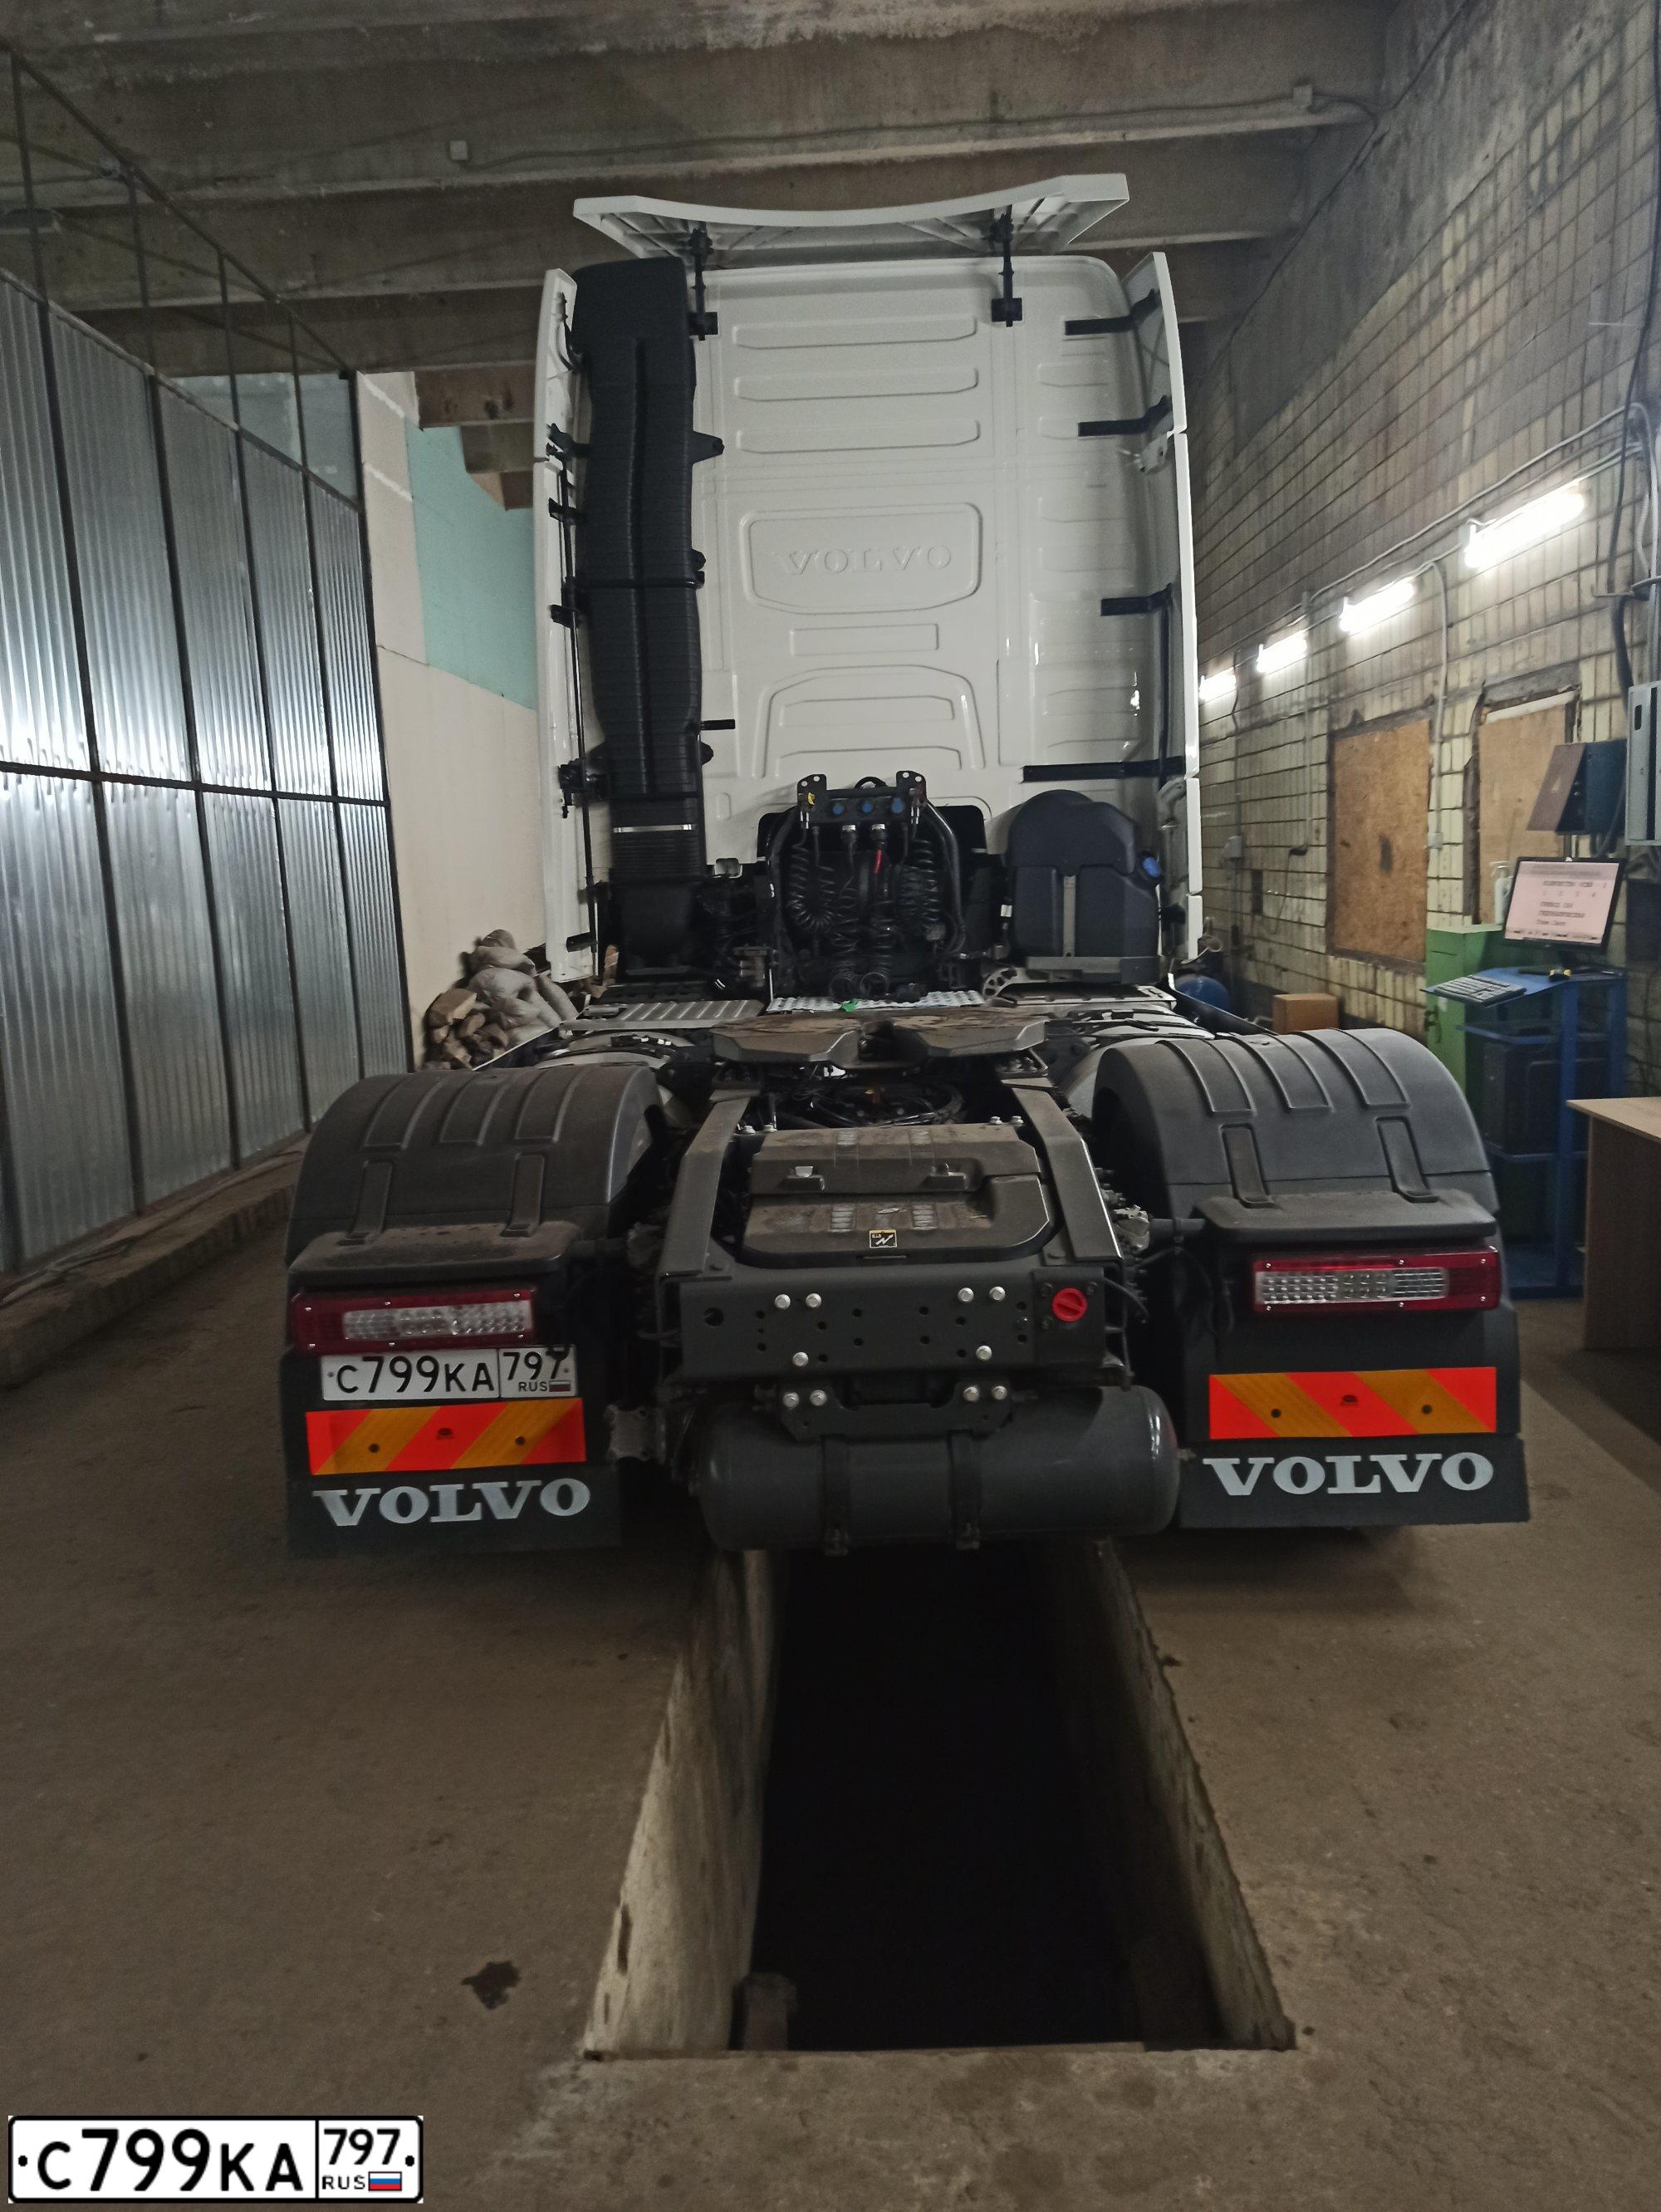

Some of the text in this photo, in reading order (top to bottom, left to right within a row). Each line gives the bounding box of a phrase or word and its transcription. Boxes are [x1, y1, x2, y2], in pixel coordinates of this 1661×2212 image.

[770, 544, 953, 576] VOLVO
[518, 1381, 548, 1392] RUS
[1203, 1452, 1494, 1496] VOLVO
[312, 1478, 590, 1527] VOLVO
